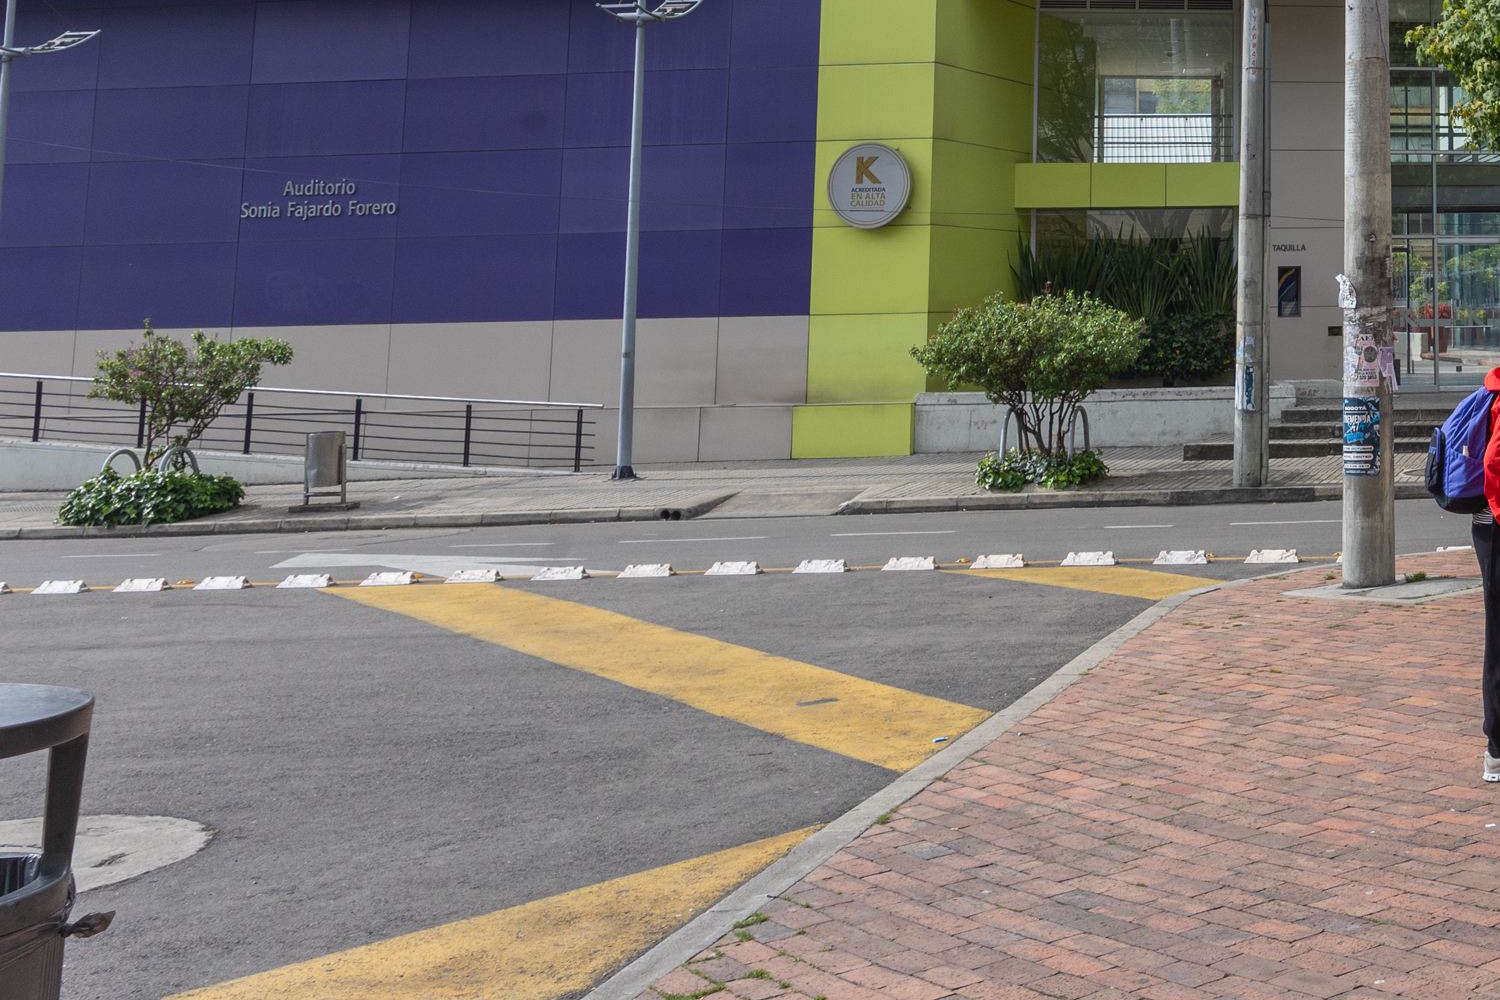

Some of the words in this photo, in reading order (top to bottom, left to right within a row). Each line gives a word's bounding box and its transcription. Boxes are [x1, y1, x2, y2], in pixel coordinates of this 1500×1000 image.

[855, 156, 882, 184] K
[283, 179, 356, 196] Auditorio
[865, 192, 886, 200] ALTA
[240, 202, 280, 218] Sonia
[287, 201, 342, 221] Fajardo
[348, 200, 396, 216] Forero
[1272, 244, 1306, 252] TAQUILLA
